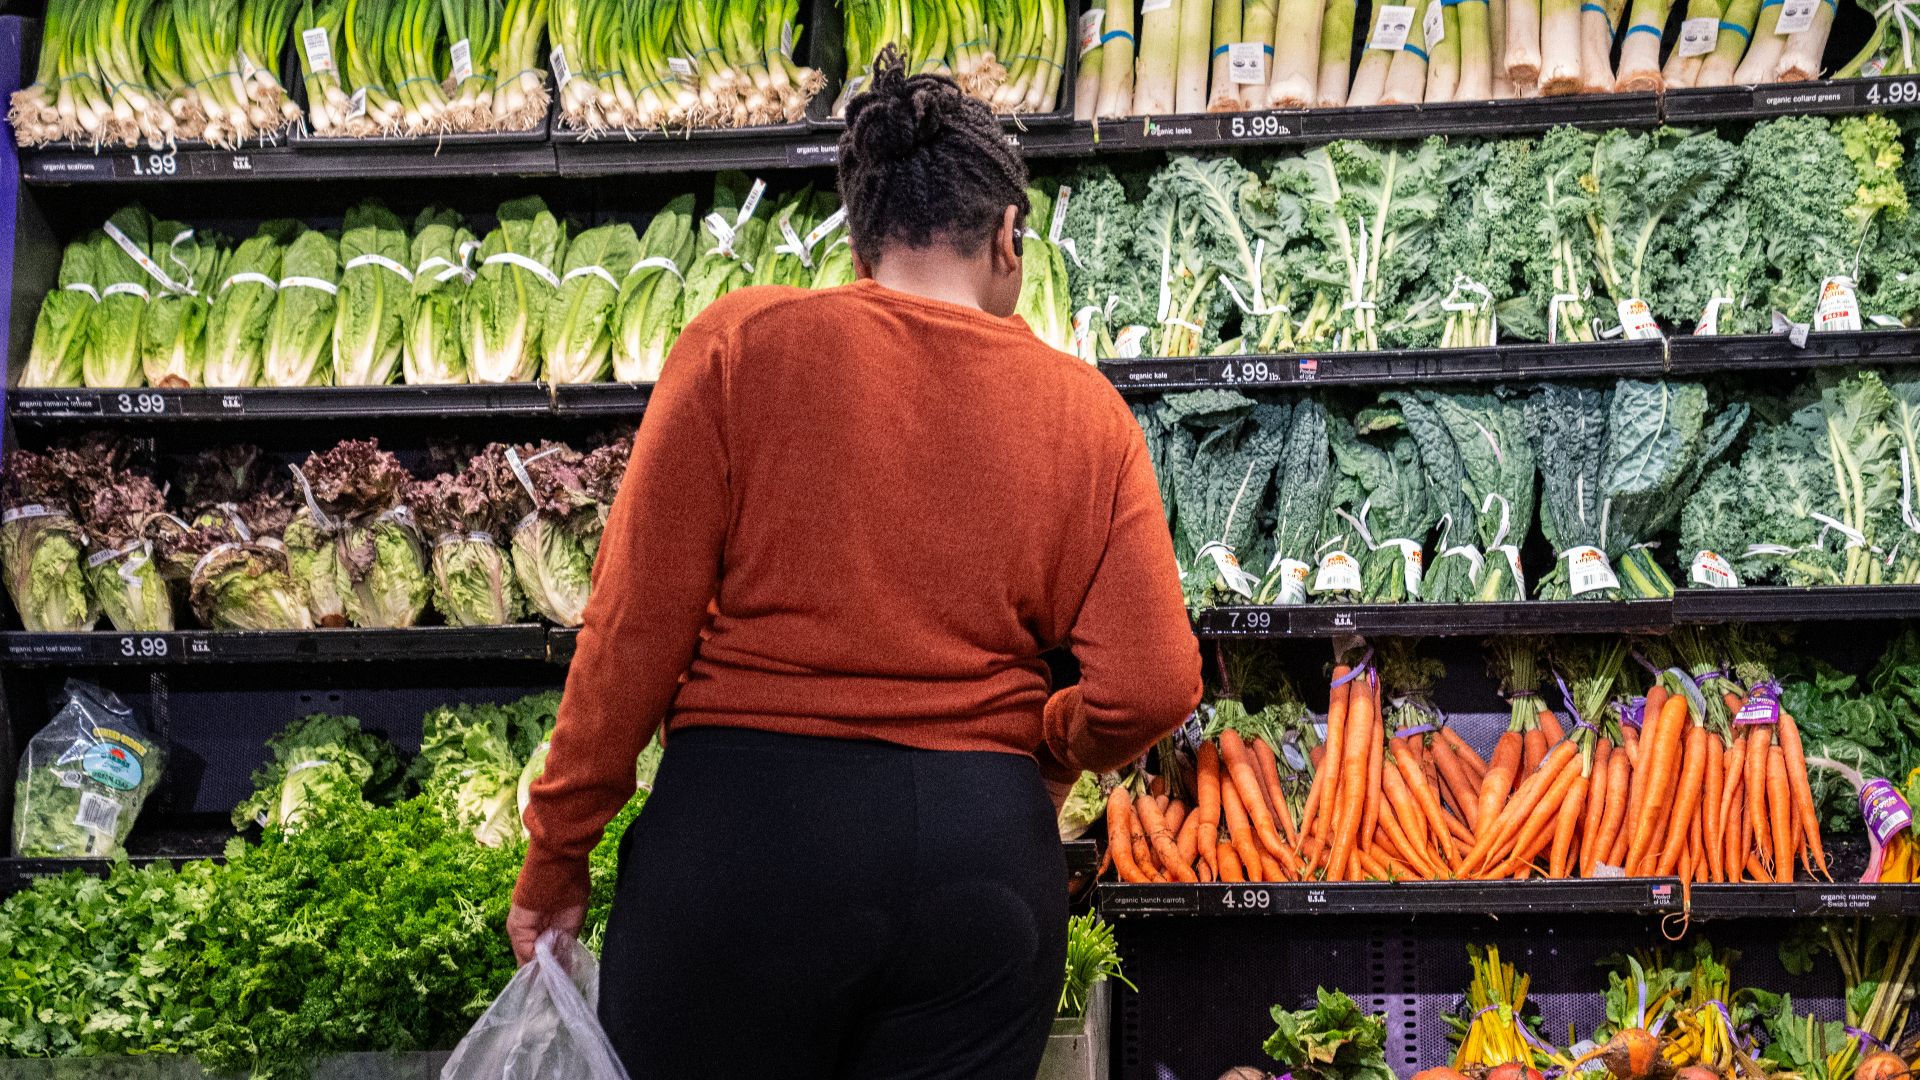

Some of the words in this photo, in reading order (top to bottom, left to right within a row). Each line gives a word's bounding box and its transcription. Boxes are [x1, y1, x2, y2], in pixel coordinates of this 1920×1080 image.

[1766, 96, 1791, 105] organic
[1793, 94, 1817, 103] collard
[1818, 93, 1841, 103] greens
[1866, 81, 1917, 104] 4.99
[131, 154, 176, 175] 1.99
[1129, 371, 1153, 381] organic
[1221, 362, 1268, 382] 4.99
[118, 394, 165, 413] 3.99
[1228, 612, 1271, 628] 7.99
[120, 637, 168, 656] 3.99
[1114, 896, 1139, 905] organic
[1140, 896, 1161, 904] bunch
[1162, 896, 1186, 904] carrots
[1221, 889, 1270, 909] 4.99
[1820, 894, 1847, 902] organic
[1848, 893, 1877, 901] rainbow
